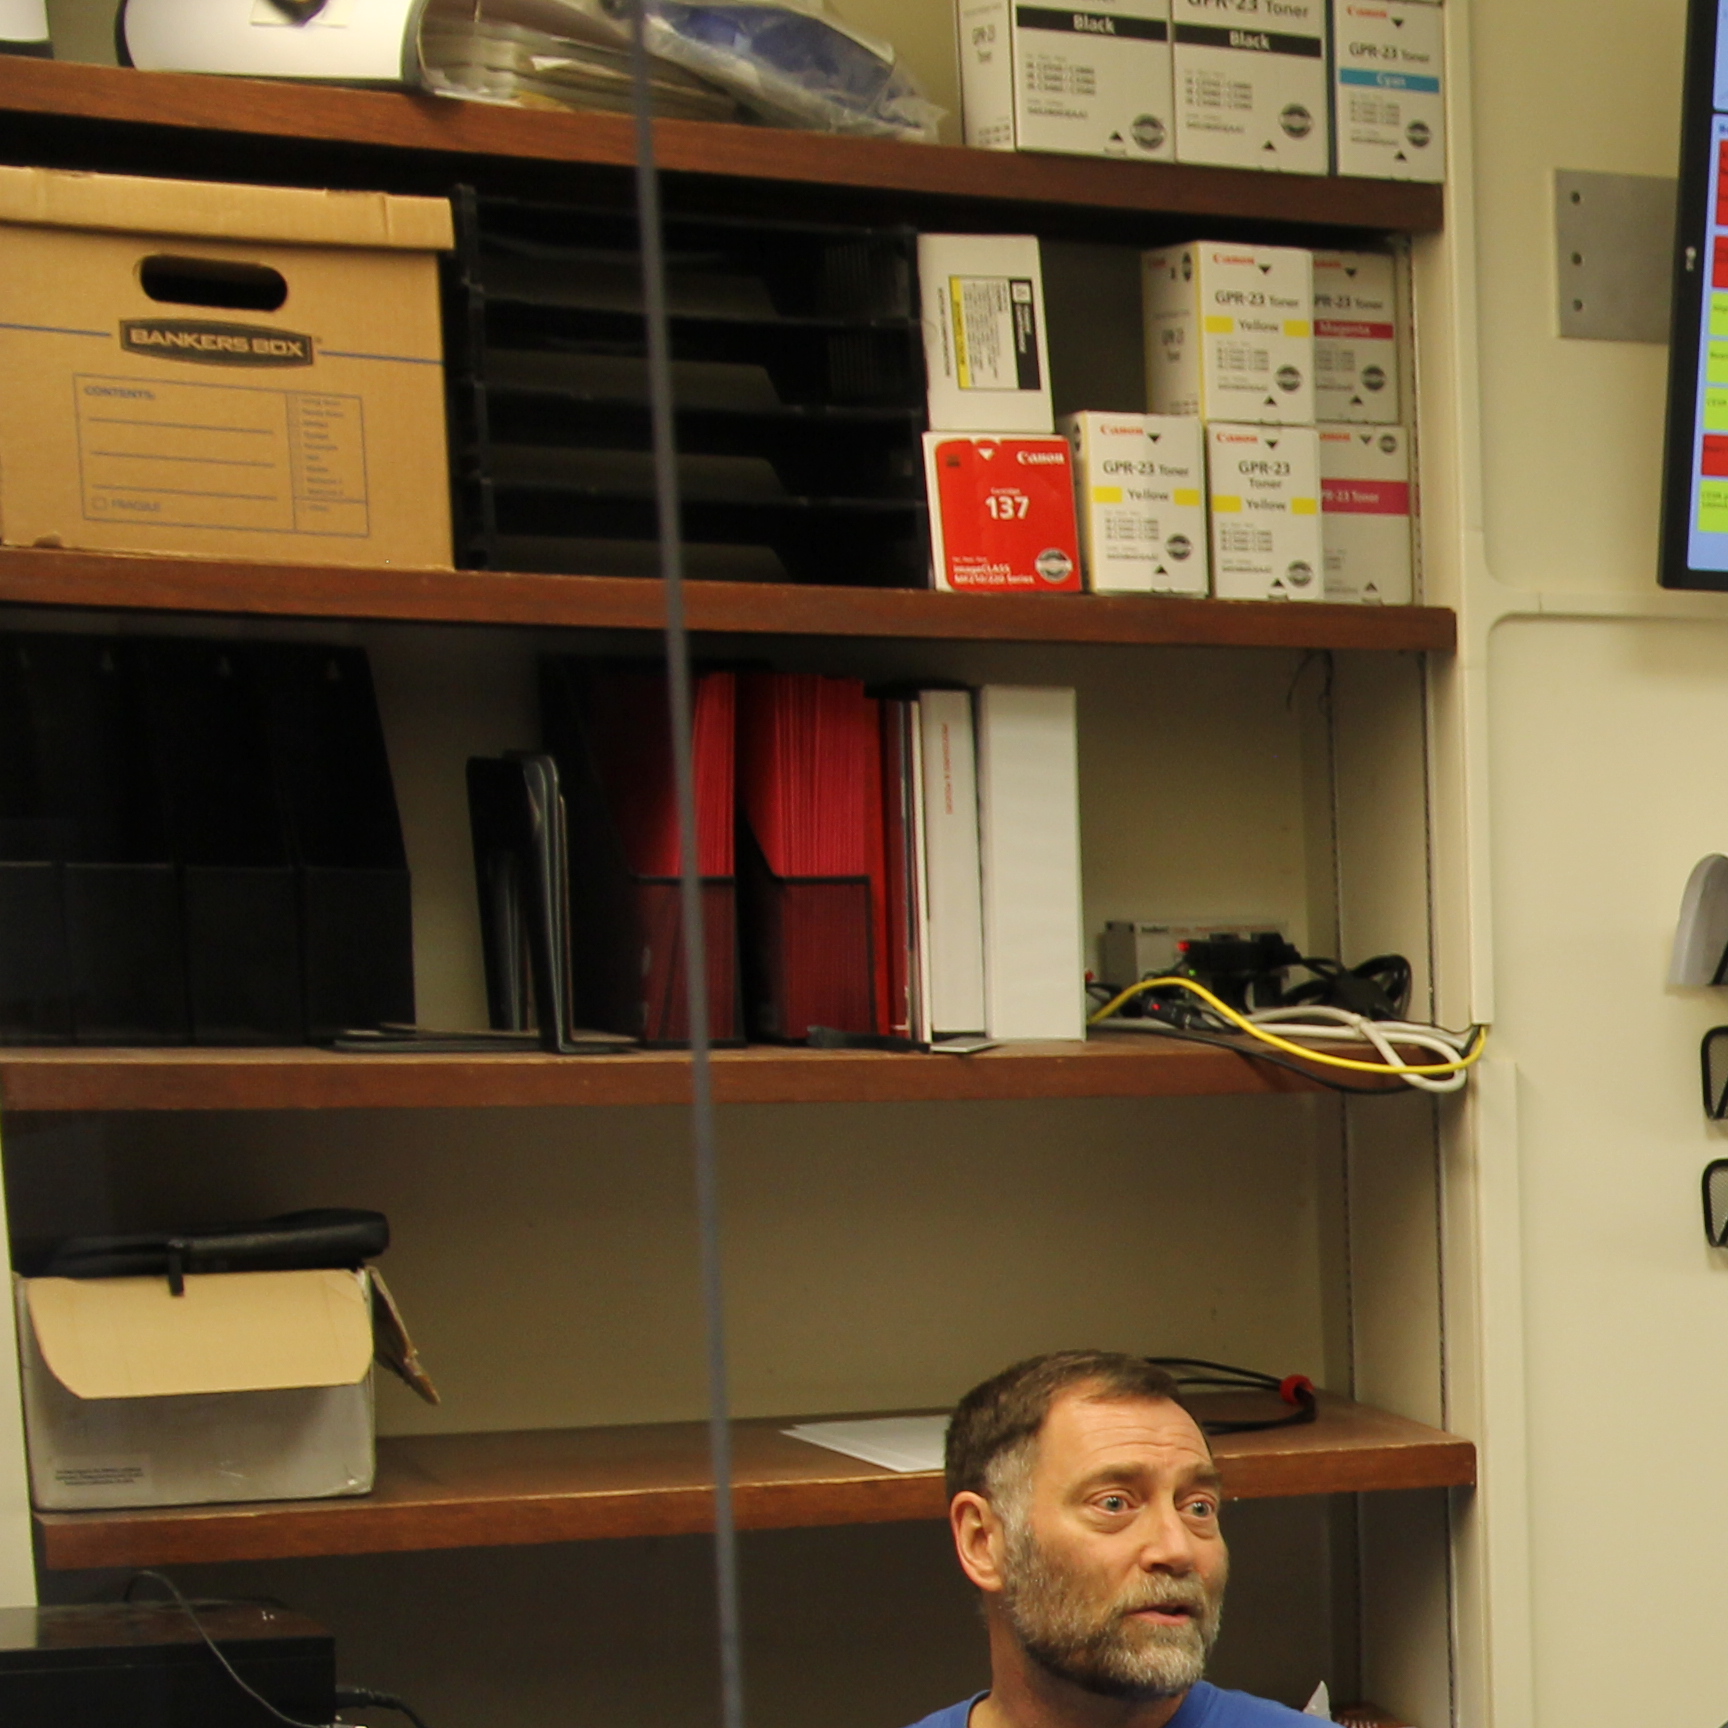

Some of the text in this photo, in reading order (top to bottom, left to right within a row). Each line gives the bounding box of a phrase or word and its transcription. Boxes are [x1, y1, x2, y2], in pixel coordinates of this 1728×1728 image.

[1266, 1, 1308, 18] Toner
[1346, 6, 1388, 18] Canon
[1073, 14, 1115, 35] Black
[1229, 31, 1270, 50] Black
[1349, 42, 1430, 63] GPR-23 Toner
[1375, 72, 1406, 88] Cyan
[1212, 253, 1256, 265] Canon
[1215, 289, 1299, 307] GPR-23 Toner
[1315, 294, 1351, 309] PR-23
[1239, 318, 1279, 332] Yellow
[1319, 320, 1370, 336] Magenta
[129, 327, 305, 357] BANKERS BOX
[1100, 424, 1144, 436] Canon
[1216, 432, 1259, 444] Canon
[1016, 450, 1066, 465] Canon
[1103, 459, 1190, 477] GPR-23 Toner
[1238, 460, 1290, 475] GPR-23
[1248, 477, 1282, 490] Toner
[1128, 488, 1169, 501] Yellow
[1322, 491, 1349, 503] PR-23
[985, 495, 1030, 520] 137
[1245, 498, 1287, 512] Yellow
